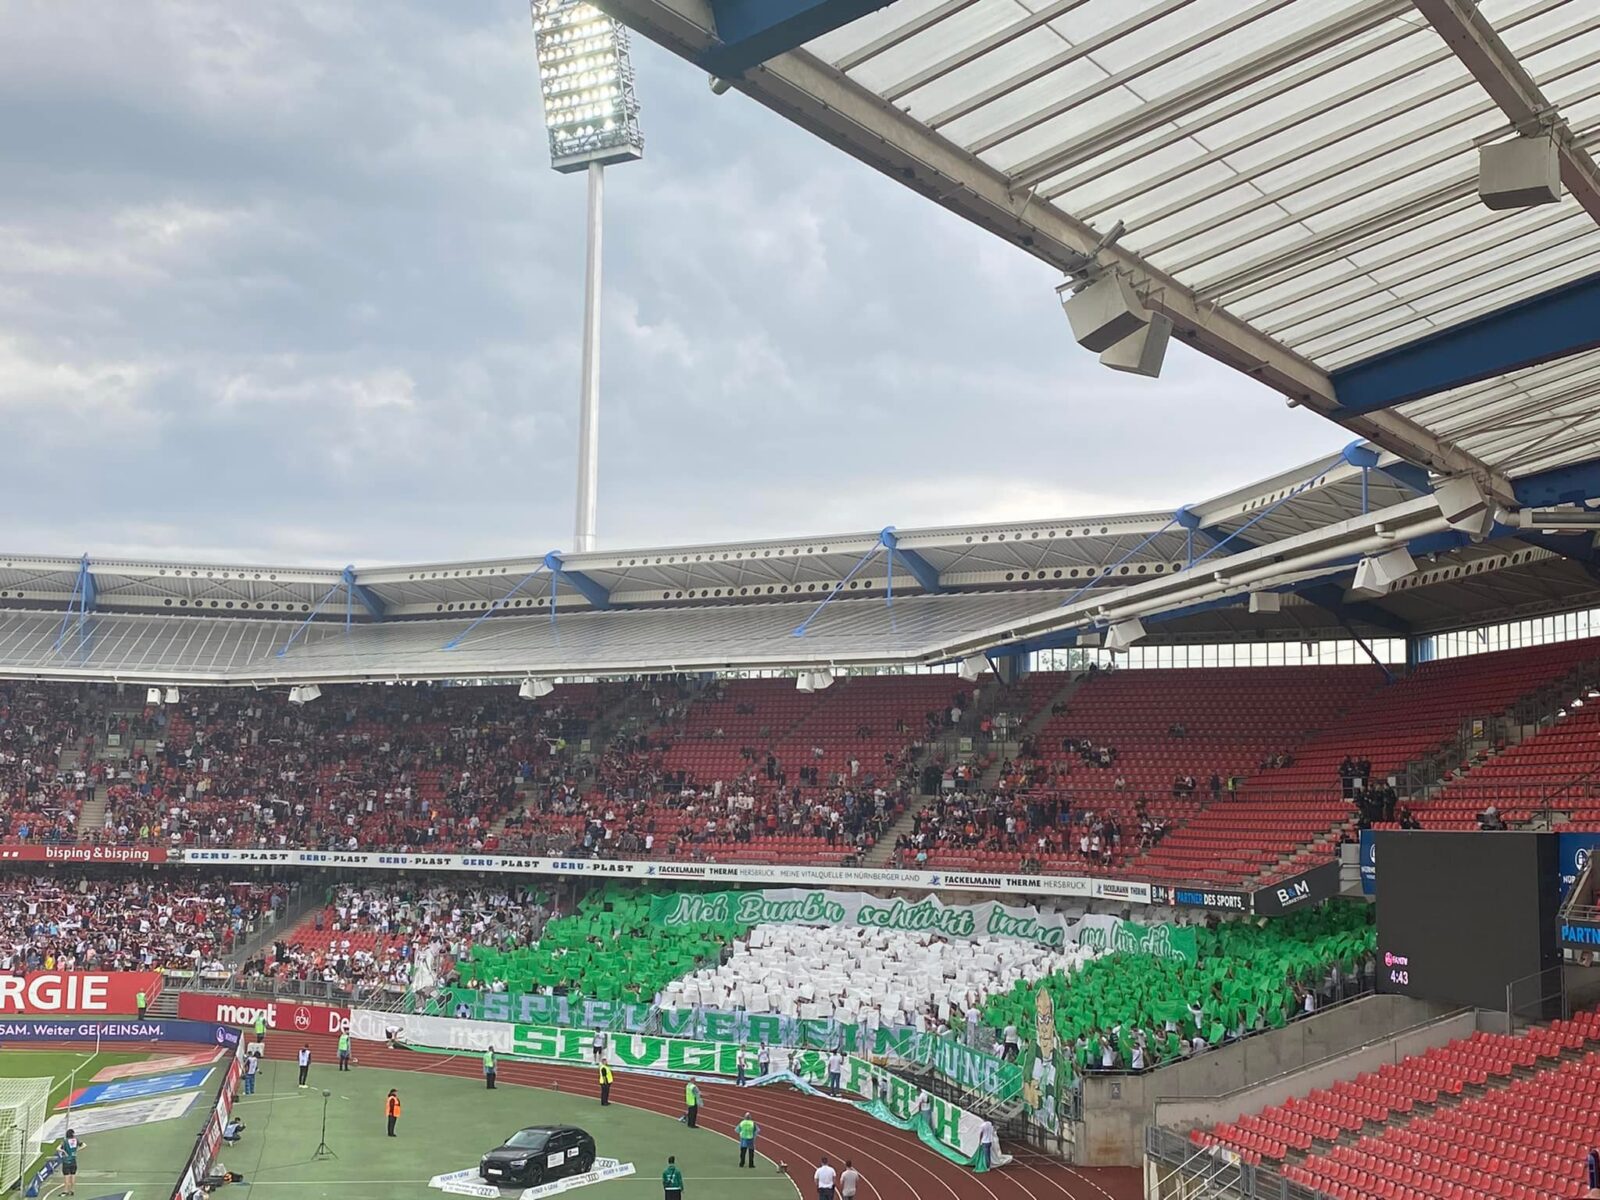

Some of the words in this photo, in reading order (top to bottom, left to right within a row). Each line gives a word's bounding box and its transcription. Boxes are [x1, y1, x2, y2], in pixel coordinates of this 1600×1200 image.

[46, 847, 91, 860] bisping
[104, 848, 149, 861] bisping
[658, 865, 705, 874] FACKELMANN
[709, 868, 738, 876] THERME
[739, 868, 775, 876] HERSBRUCK
[801, 870, 844, 879] VITALQUELLE
[852, 872, 900, 881] NÜRNBERGER
[901, 874, 920, 882] LAND
[944, 876, 1001, 886] FACKELMANN
[1006, 878, 1041, 887] THERME
[1043, 880, 1087, 889] HERSBRUCK
[1276, 880, 1310, 903] B&M
[1203, 894, 1216, 906] DES
[665, 894, 729, 927] Mei
[1390, 970, 1409, 985] 4:43
[0, 975, 108, 1010] RGIE
[34, 1024, 76, 1036] Weiter
[78, 1024, 163, 1036] GEMEINSAM.
